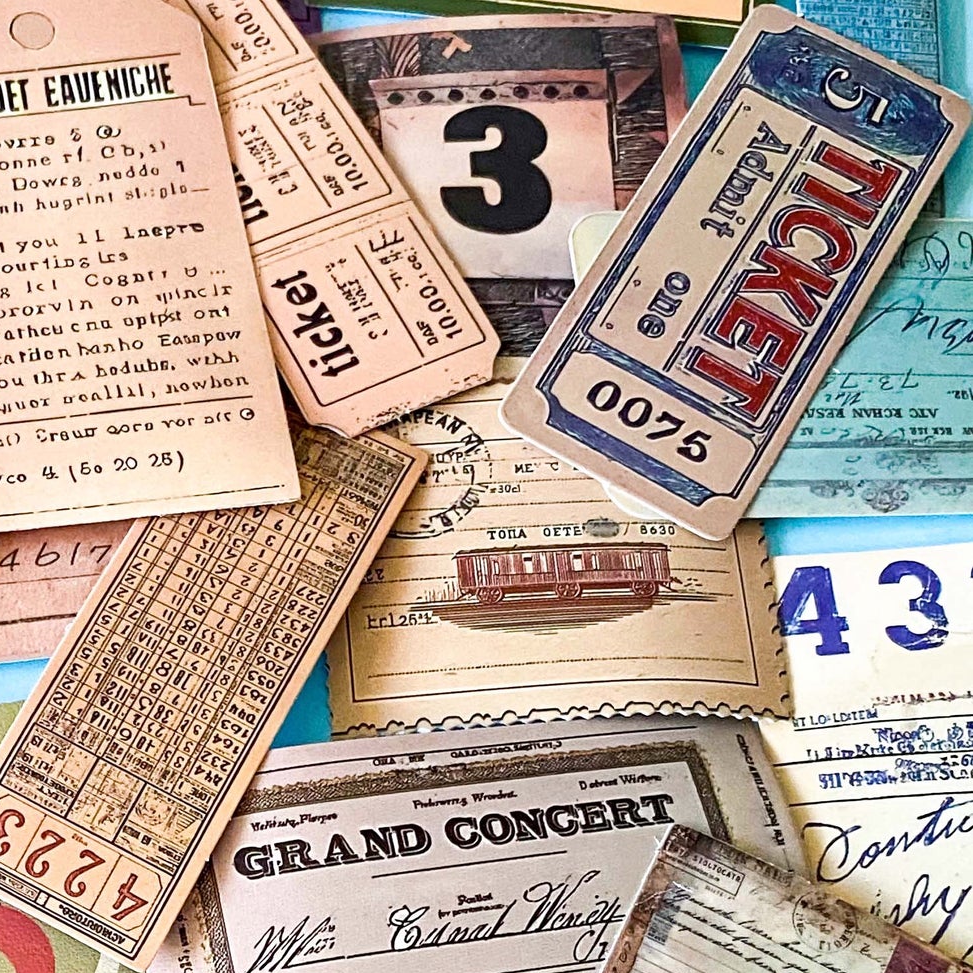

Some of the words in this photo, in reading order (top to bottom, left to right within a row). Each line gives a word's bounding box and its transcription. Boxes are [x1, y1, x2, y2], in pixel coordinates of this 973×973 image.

[441, 100, 549, 237] 3
[701, 121, 792, 240] Admit
[270, 269, 361, 378] ticket
[636, 269, 691, 339] one
[685, 140, 908, 420] TICKET
[586, 380, 714, 465] 0075
[233, 823, 432, 881] GRAND
[443, 792, 676, 851] CONCERT
